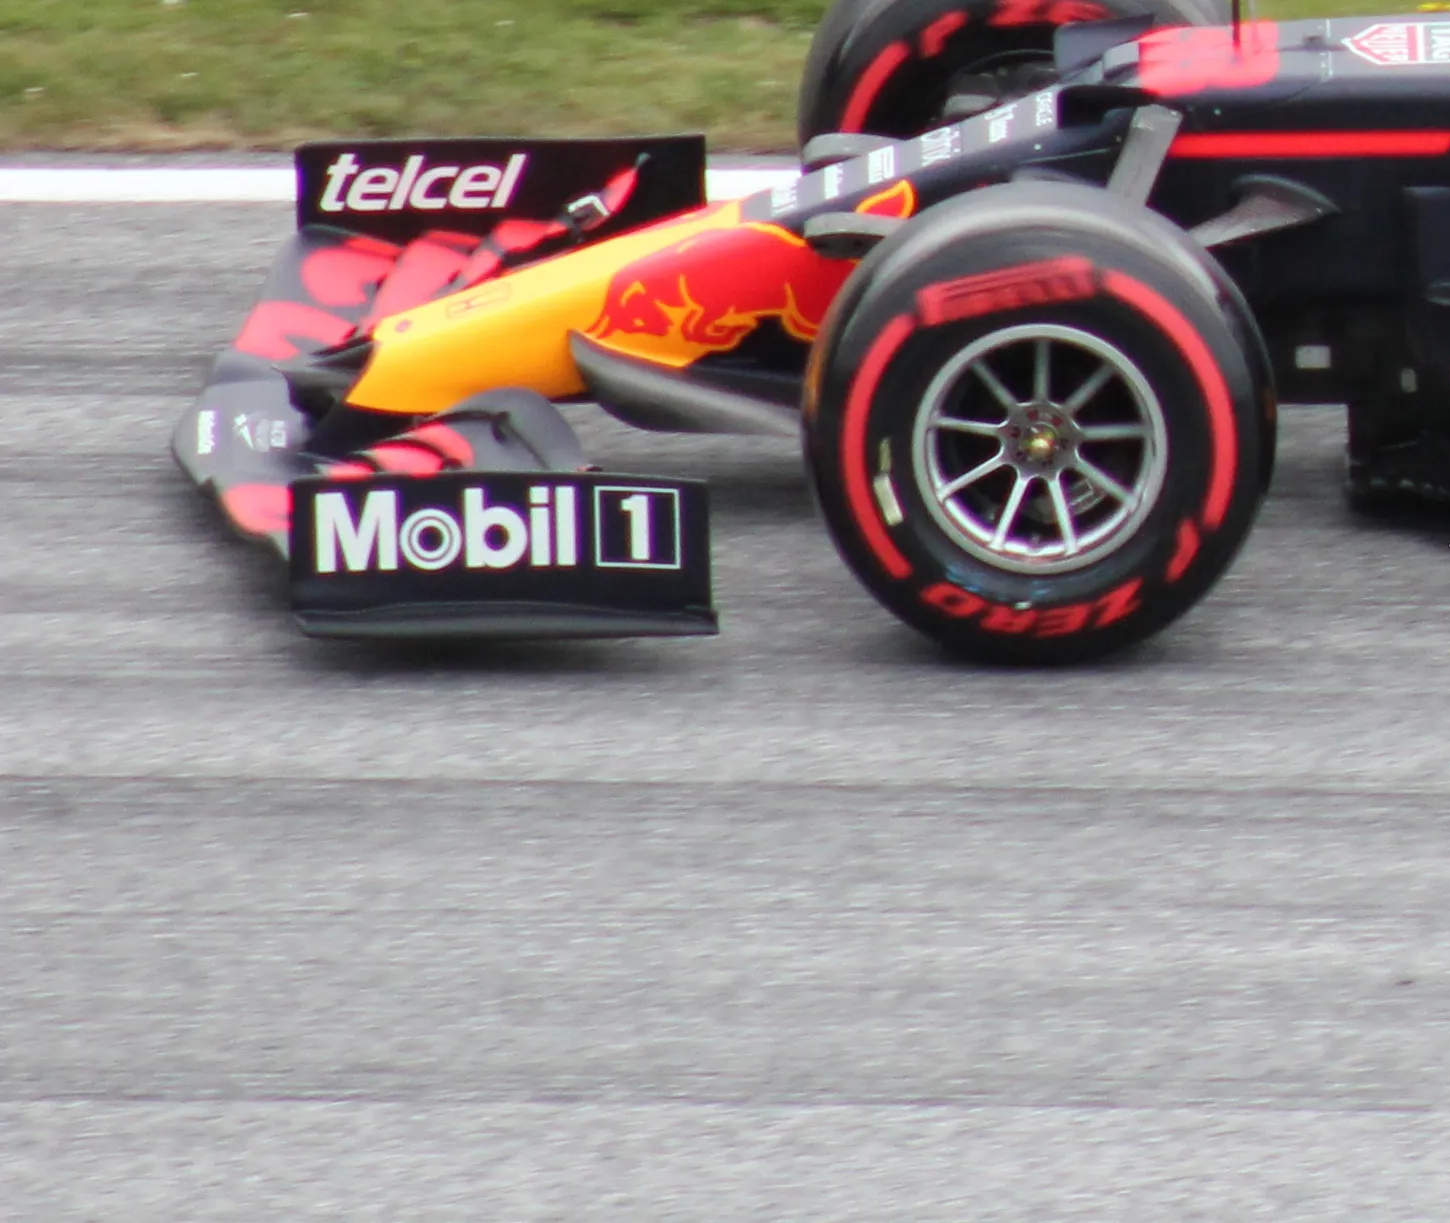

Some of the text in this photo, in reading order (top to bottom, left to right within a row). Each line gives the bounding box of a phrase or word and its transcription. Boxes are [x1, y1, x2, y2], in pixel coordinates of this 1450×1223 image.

[319, 153, 528, 213] telcel
[313, 485, 652, 574] Mobil 1
